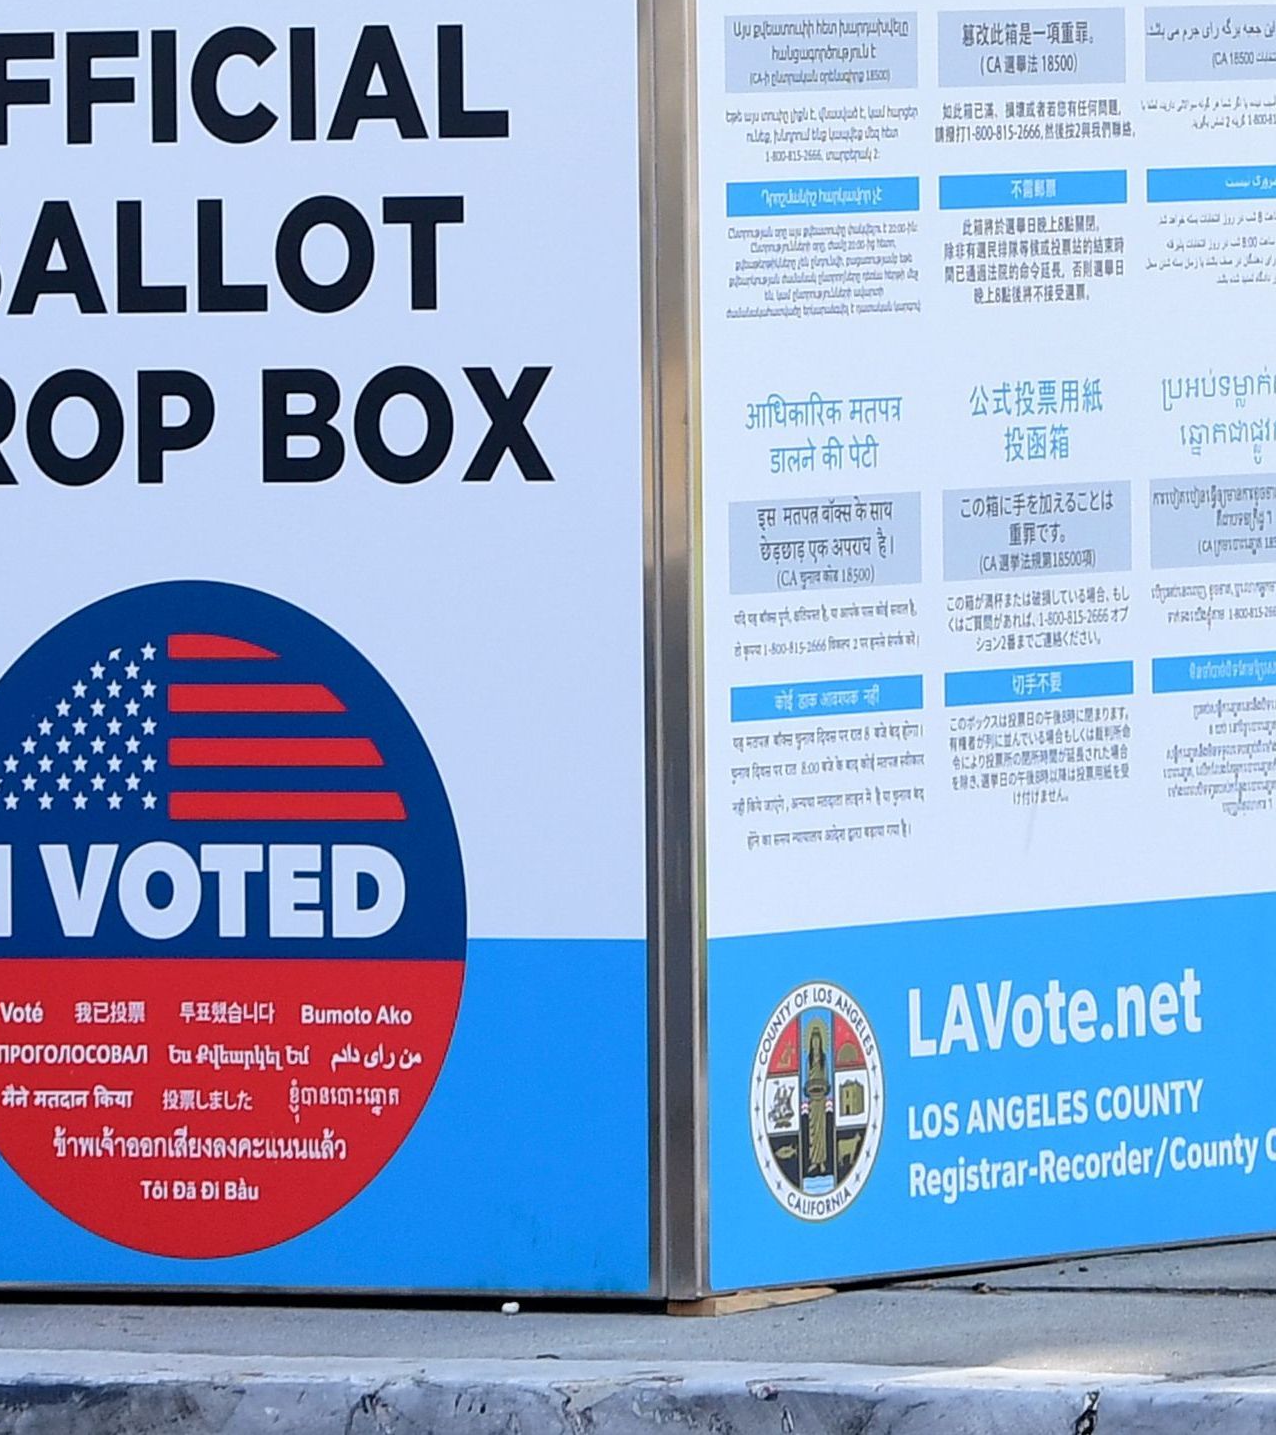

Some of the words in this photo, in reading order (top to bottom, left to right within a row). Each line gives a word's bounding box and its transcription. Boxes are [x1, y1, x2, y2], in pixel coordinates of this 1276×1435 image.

[1042, 52, 1079, 73] 18500)
[745, 392, 843, 430] आधिकारिक
[849, 396, 903, 424] मतपत्र
[969, 378, 1103, 416] 公式投票用紙
[262, 364, 556, 483] BOX
[770, 437, 817, 474] डालने
[821, 435, 845, 471] की
[849, 433, 880, 469] पेटी
[1004, 423, 1069, 463] 投函箱
[960, 489, 1114, 519] この箱に手を加えることは
[1008, 521, 1066, 547] 重罪です。
[807, 538, 829, 564] एक
[841, 564, 875, 584] 18500)
[39, 840, 406, 940] VOTED
[0, 1002, 44, 1024] Voté
[75, 1001, 146, 1025] 我已投票
[180, 1001, 276, 1025] 투표했습니다
[300, 1005, 372, 1025] Bumoto
[376, 1005, 413, 1026] Ako
[759, 1000, 792, 1066] COUNTY
[794, 991, 809, 1008] OF
[813, 987, 833, 1004] LOS
[834, 997, 874, 1057] ANGELES
[908, 967, 1203, 1058] LAVote.net
[33, 1089, 89, 1109] मतदान
[93, 1084, 134, 1109] किया
[162, 1089, 253, 1111] 投票しました
[908, 1102, 959, 1140] LOS
[966, 1089, 1089, 1136] ANGELES
[1095, 1079, 1204, 1125] COUNTY
[909, 1135, 1259, 1205] Registrar-Recorder/County
[140, 1180, 168, 1201] Tôi
[786, 1187, 853, 1216] CALIFORNIA
